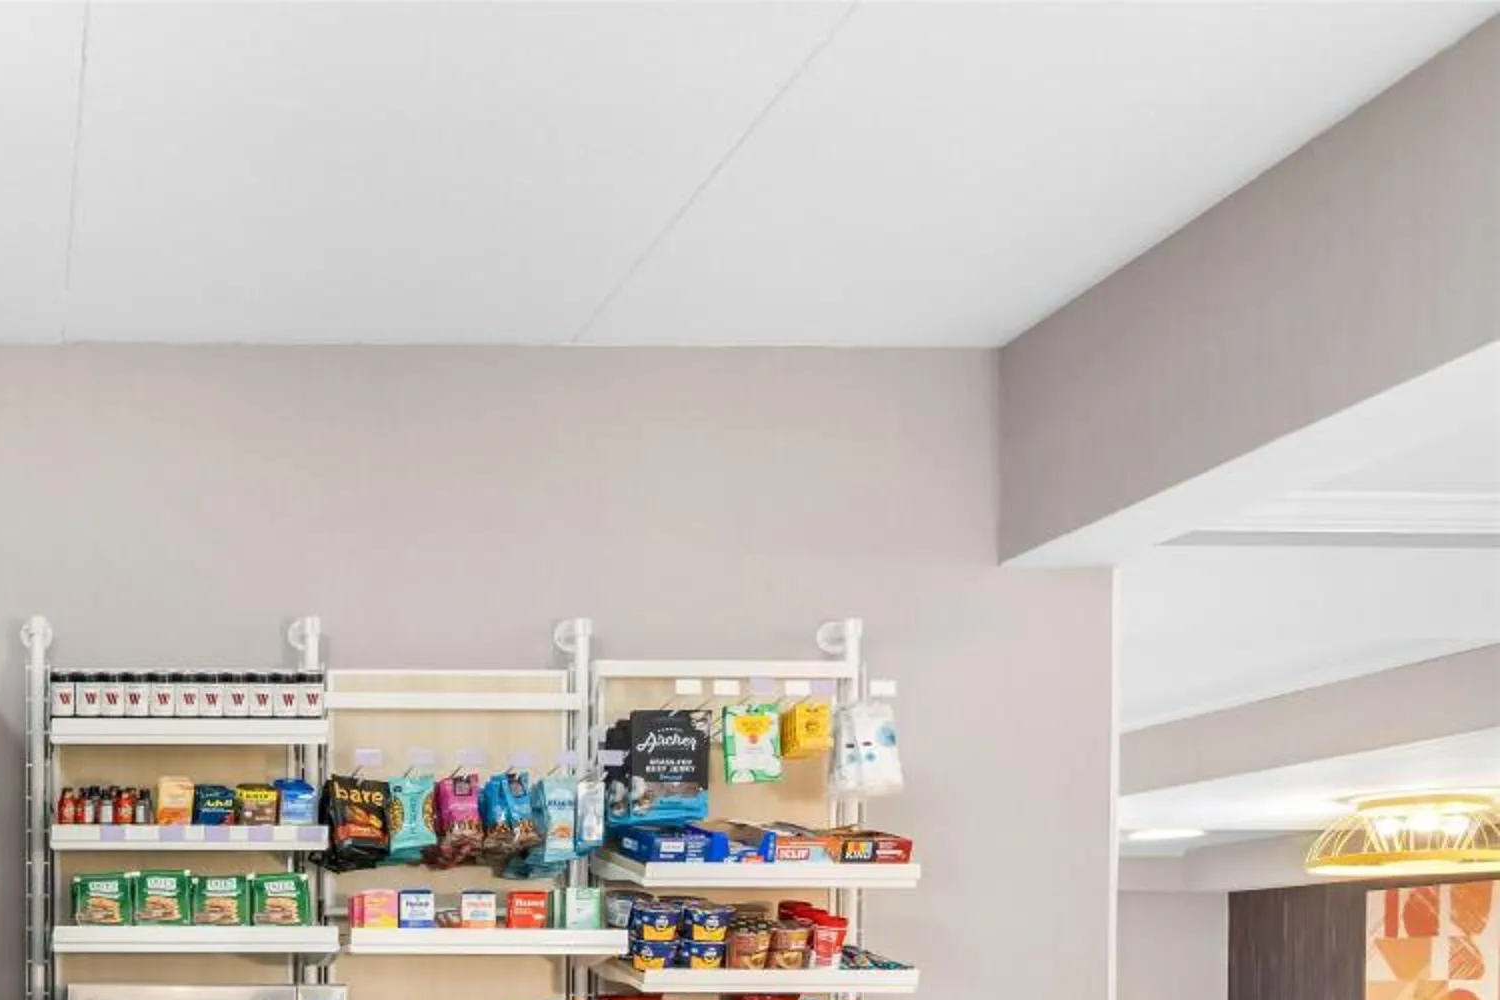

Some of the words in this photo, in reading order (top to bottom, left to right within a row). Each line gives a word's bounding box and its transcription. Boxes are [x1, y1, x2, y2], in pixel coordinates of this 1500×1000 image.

[60, 692, 72, 705] W
[85, 692, 97, 705] W
[106, 692, 119, 705] W
[129, 692, 141, 705] W
[158, 692, 170, 705] W
[183, 692, 196, 705] W
[206, 693, 218, 706] W
[232, 693, 244, 706] W
[257, 693, 268, 706] W
[283, 693, 295, 706] W
[307, 693, 319, 706] W
[334, 781, 384, 807] bare
[845, 850, 871, 860] KIND
